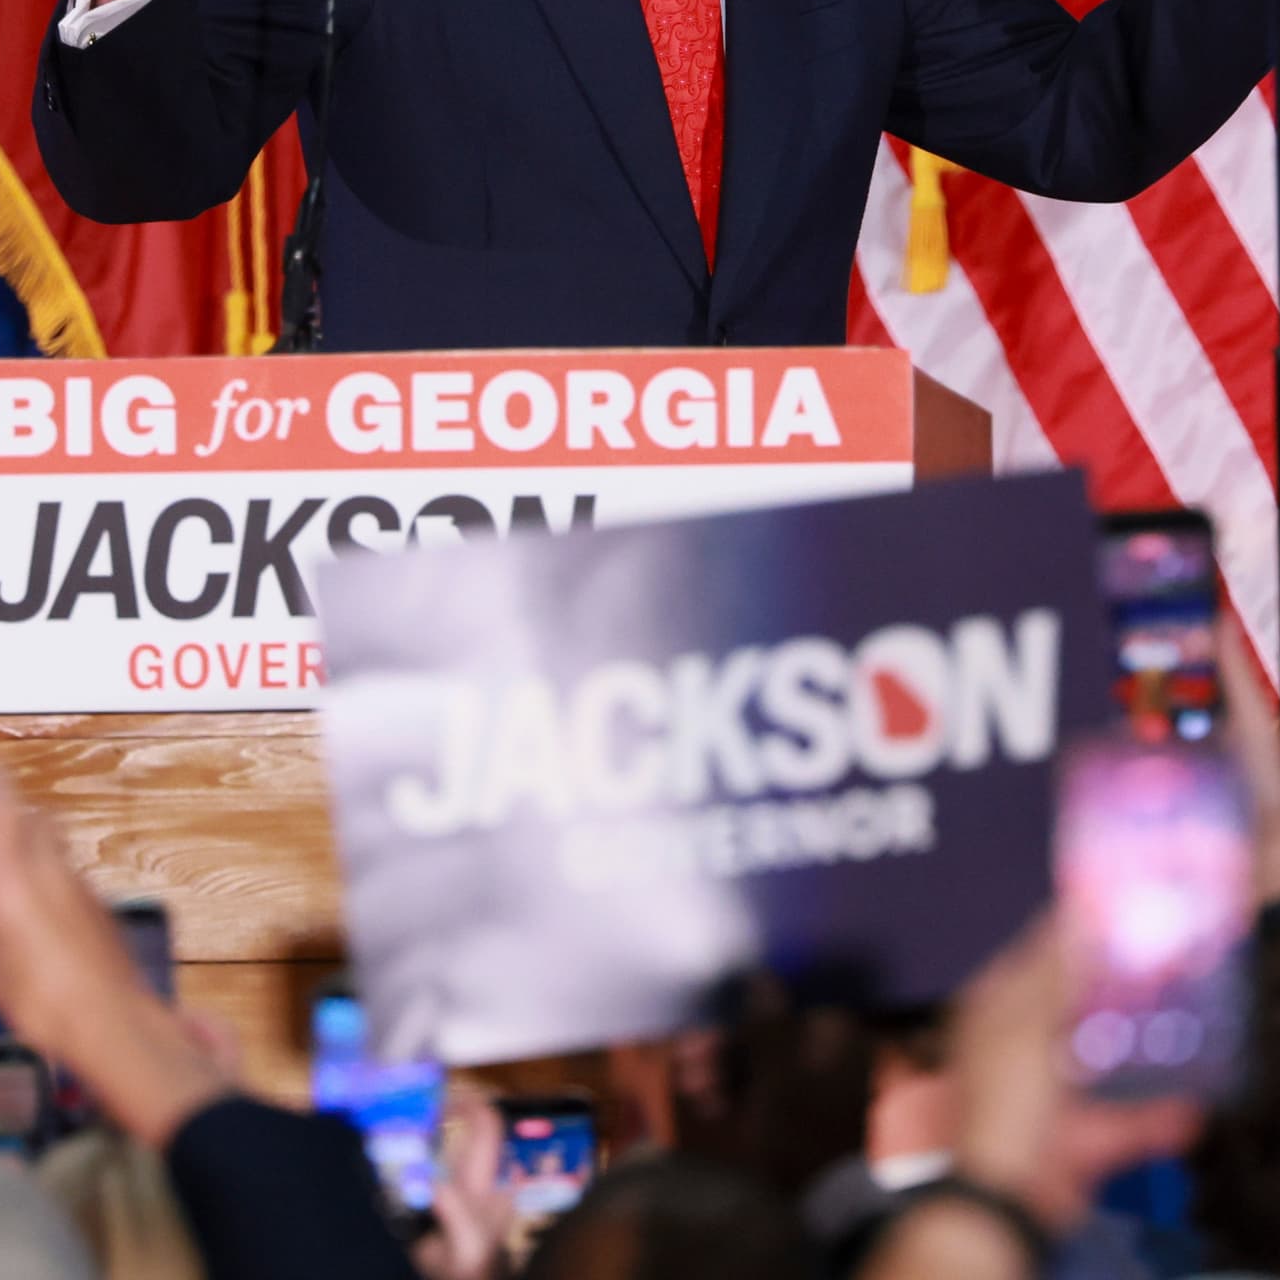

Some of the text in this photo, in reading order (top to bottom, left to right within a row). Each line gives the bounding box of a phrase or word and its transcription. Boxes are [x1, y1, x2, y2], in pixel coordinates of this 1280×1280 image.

[194, 378, 310, 458] for
[325, 366, 842, 454] GEORGIA
[128, 642, 329, 691] GOVER
[386, 609, 1063, 834] JACKSON
